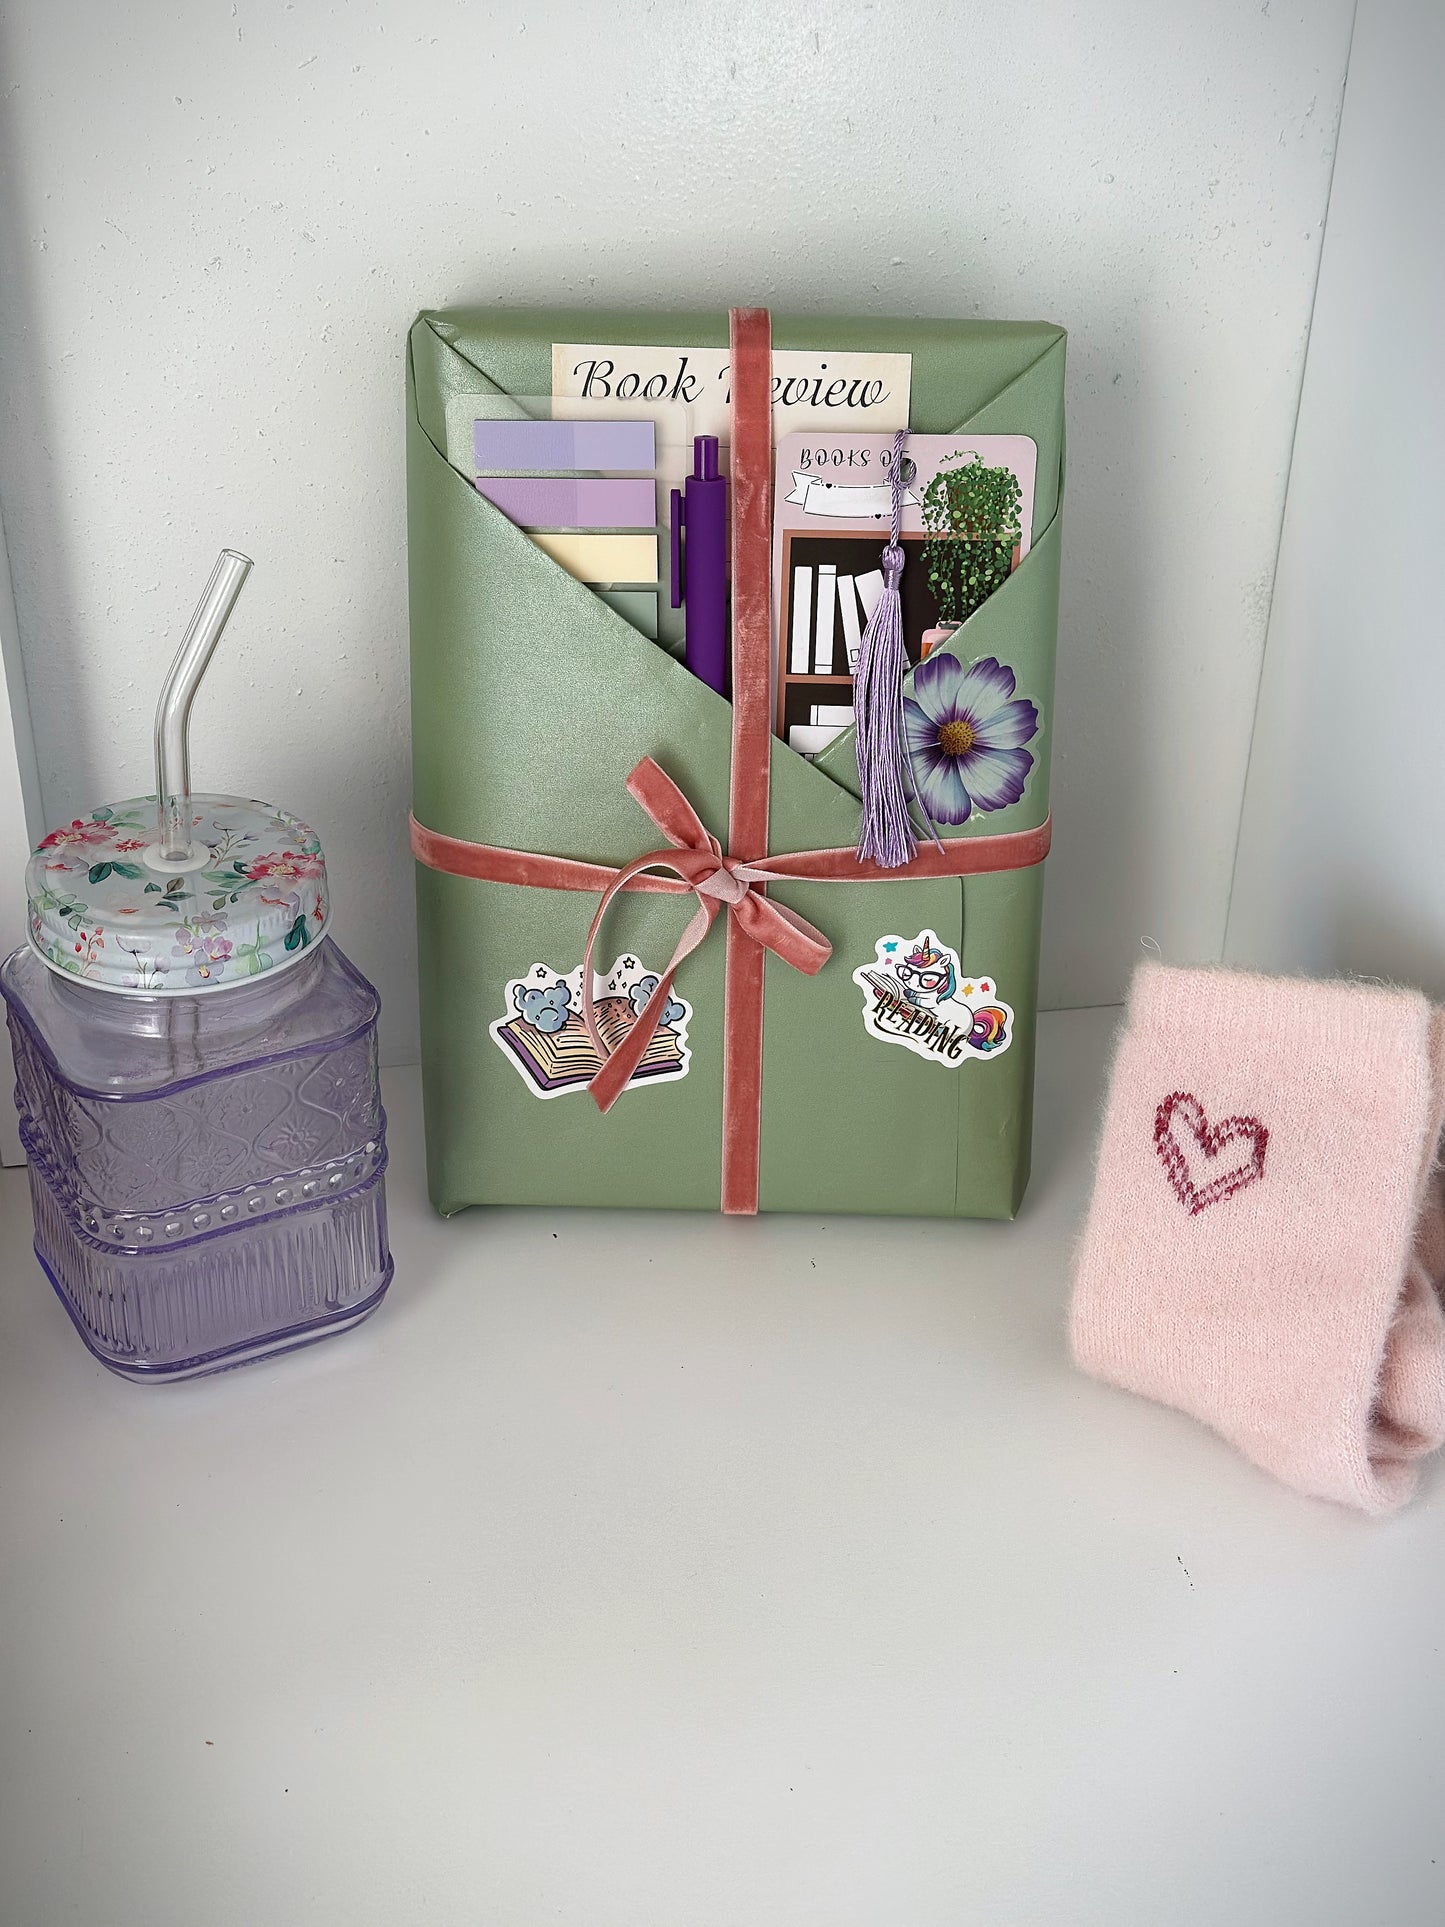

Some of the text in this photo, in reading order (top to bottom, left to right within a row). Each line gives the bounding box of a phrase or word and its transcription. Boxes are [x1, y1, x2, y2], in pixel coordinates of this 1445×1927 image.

[573, 357, 891, 411] Book eview
[799, 448, 871, 470] BOOKS
[872, 990, 969, 1060] READING
